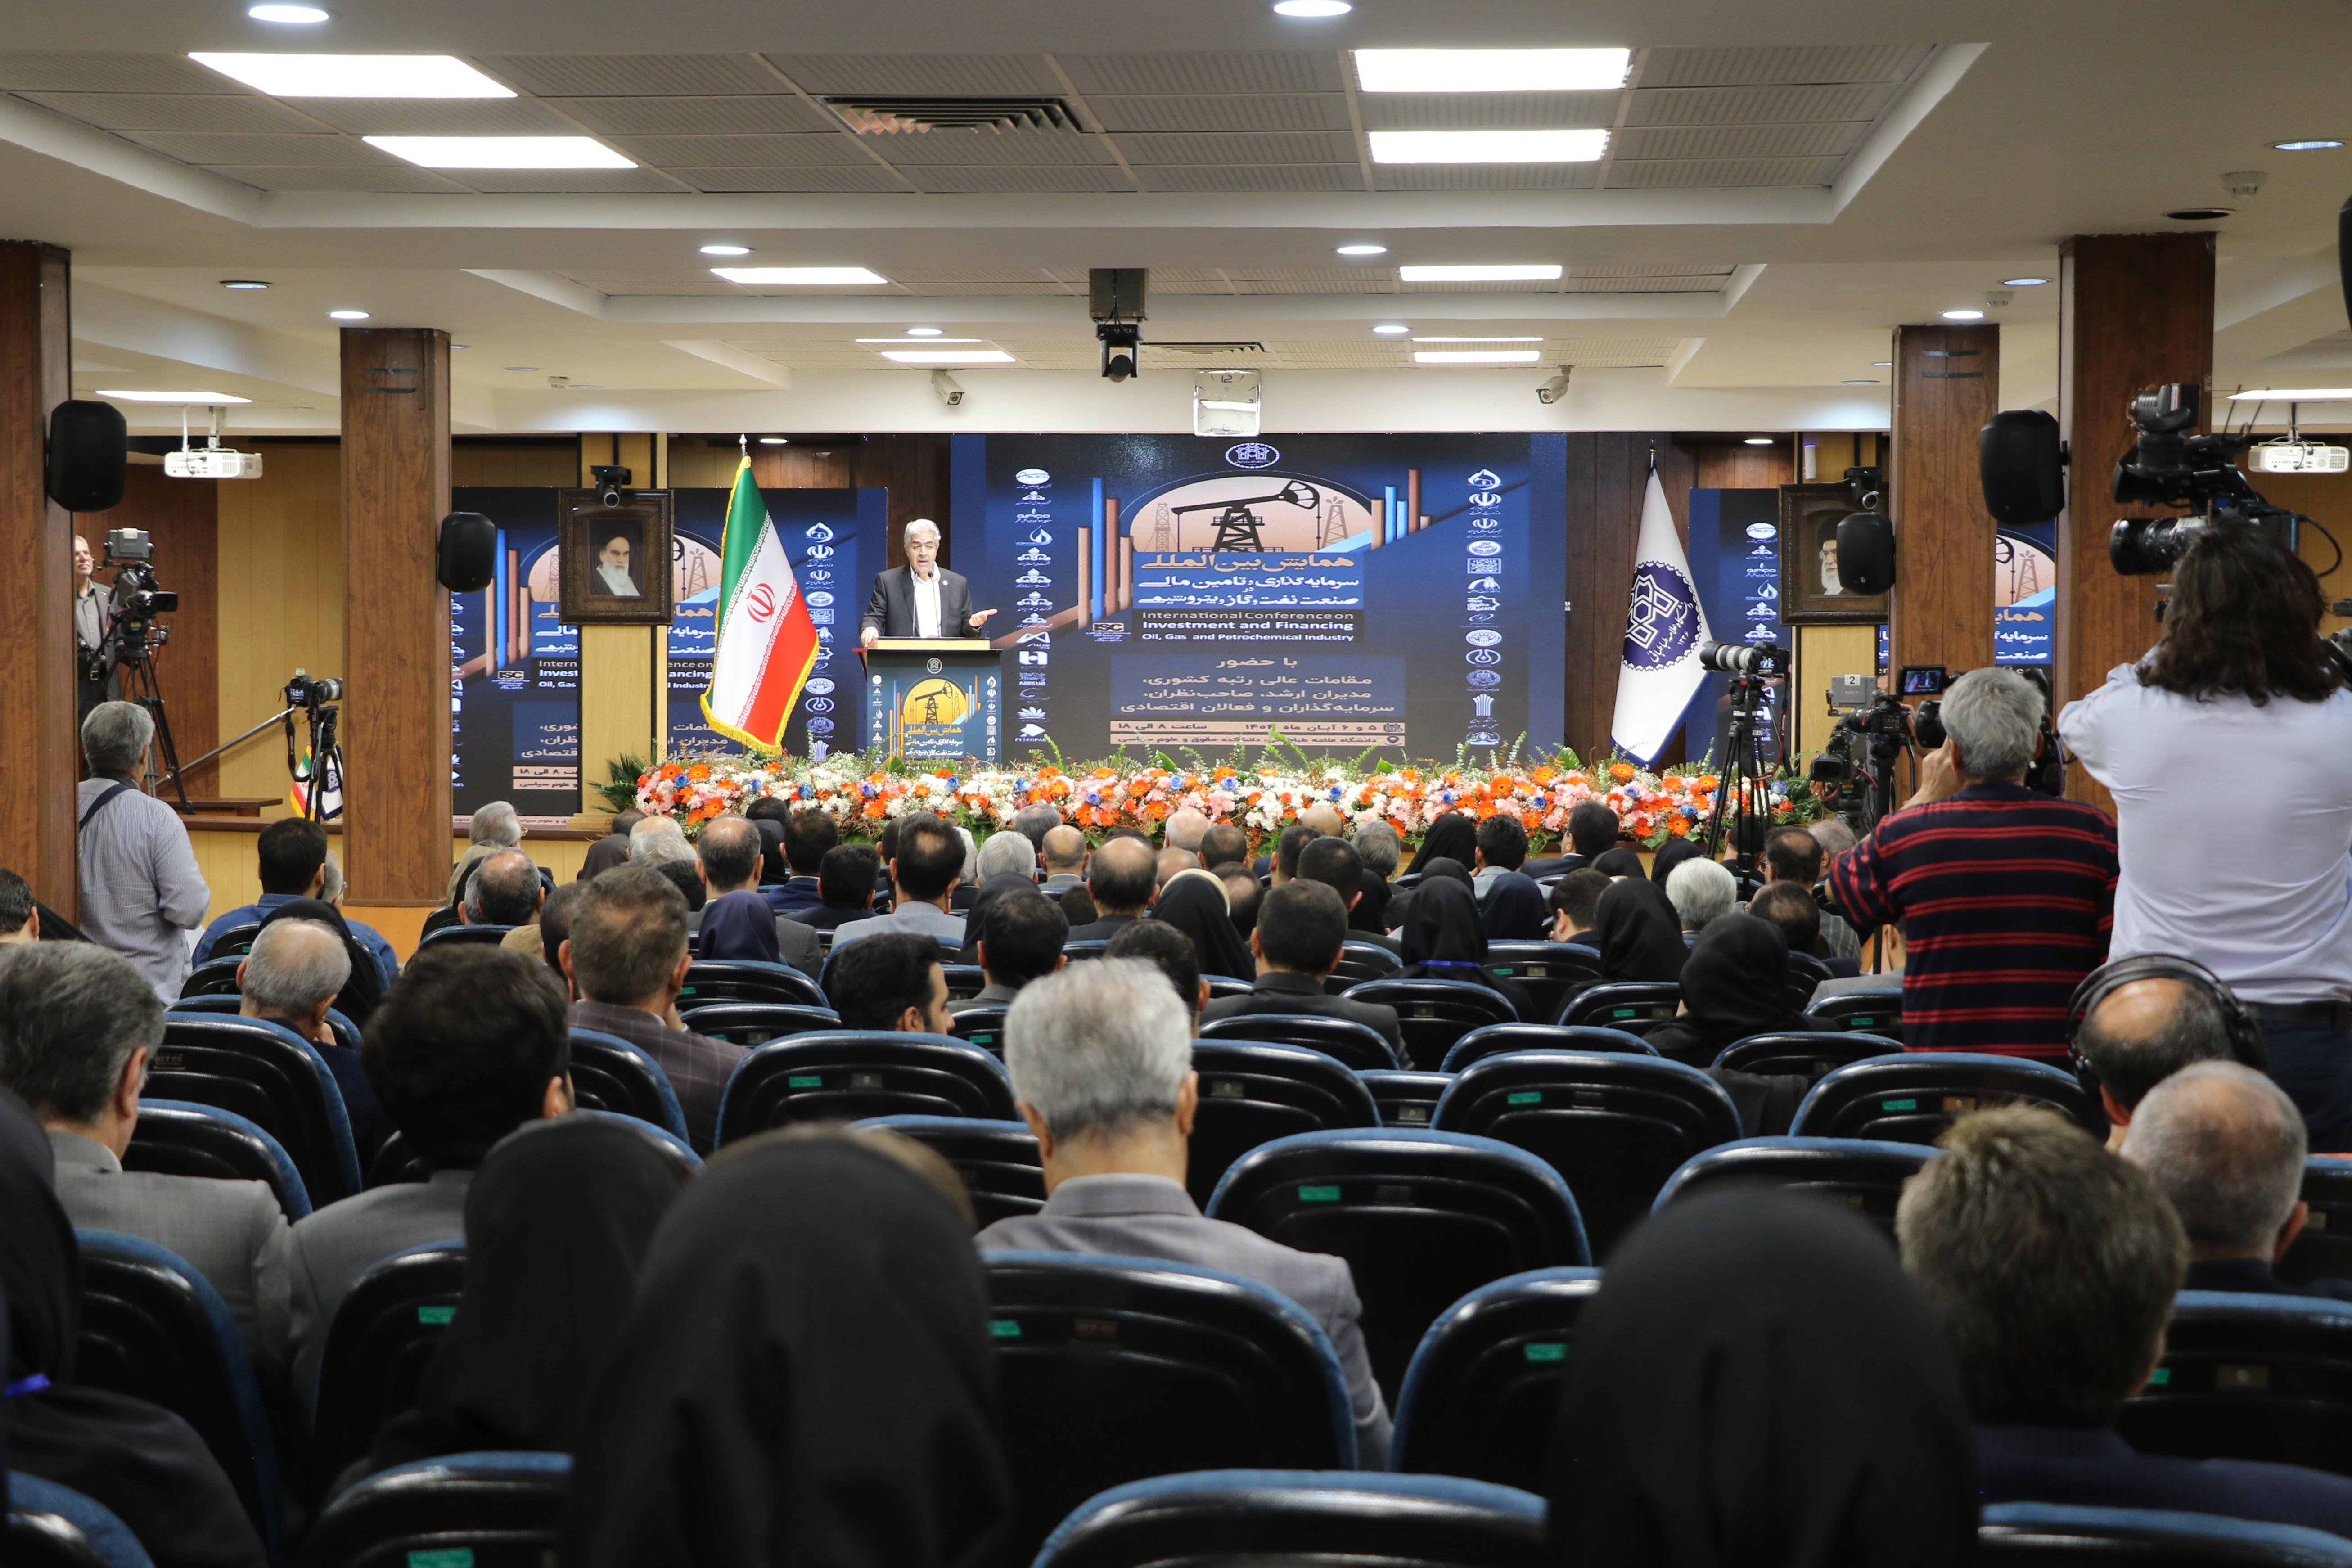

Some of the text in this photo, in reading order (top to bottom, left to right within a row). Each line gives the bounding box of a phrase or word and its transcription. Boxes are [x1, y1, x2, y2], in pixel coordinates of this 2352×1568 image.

[1261, 554, 1355, 572] همایش
[1138, 595, 1219, 605] پتروشیمی
[1223, 594, 1253, 607] گاز
[1259, 595, 1298, 604] نفت
[1300, 596, 1359, 605] صنعت
[1275, 622, 1354, 631] Financing
[1995, 651, 2048, 659] صنعت
[1216, 657, 1298, 668] با حضور
[1217, 676, 1253, 685] رتبه
[1260, 676, 1297, 685] عالی
[1305, 676, 1372, 685] مقامات
[1849, 676, 1855, 685] 2
[1312, 690, 1371, 700] مدیران
[1120, 702, 1194, 712] اقتصادی
[1201, 702, 1255, 713] فعالان
[1262, 705, 1272, 713] و
